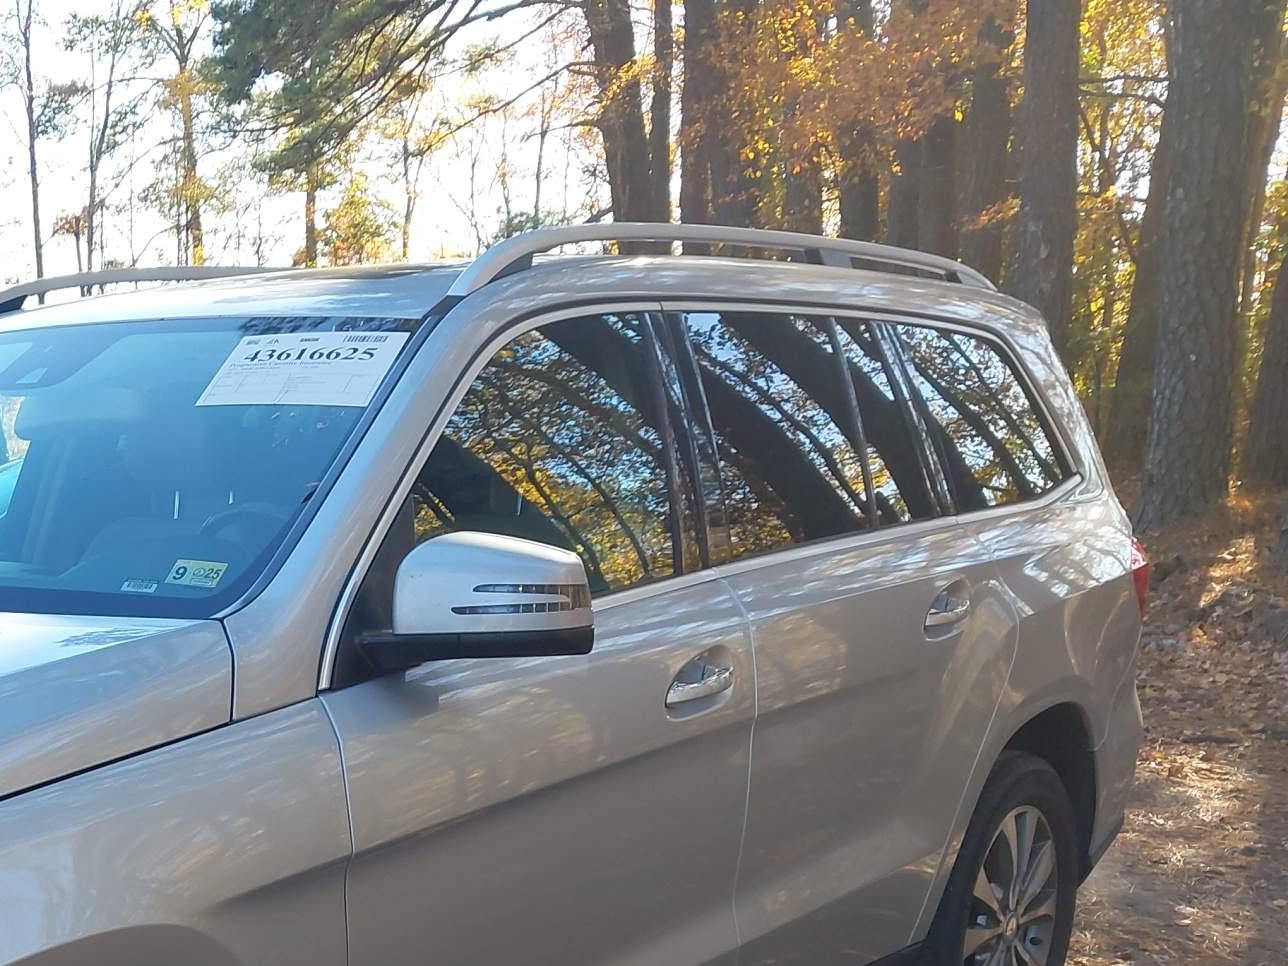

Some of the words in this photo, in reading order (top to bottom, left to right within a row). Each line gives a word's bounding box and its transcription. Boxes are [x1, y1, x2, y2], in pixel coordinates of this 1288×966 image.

[244, 347, 378, 362] 43616625
[172, 566, 188, 580] 9
[204, 568, 222, 580] 25
